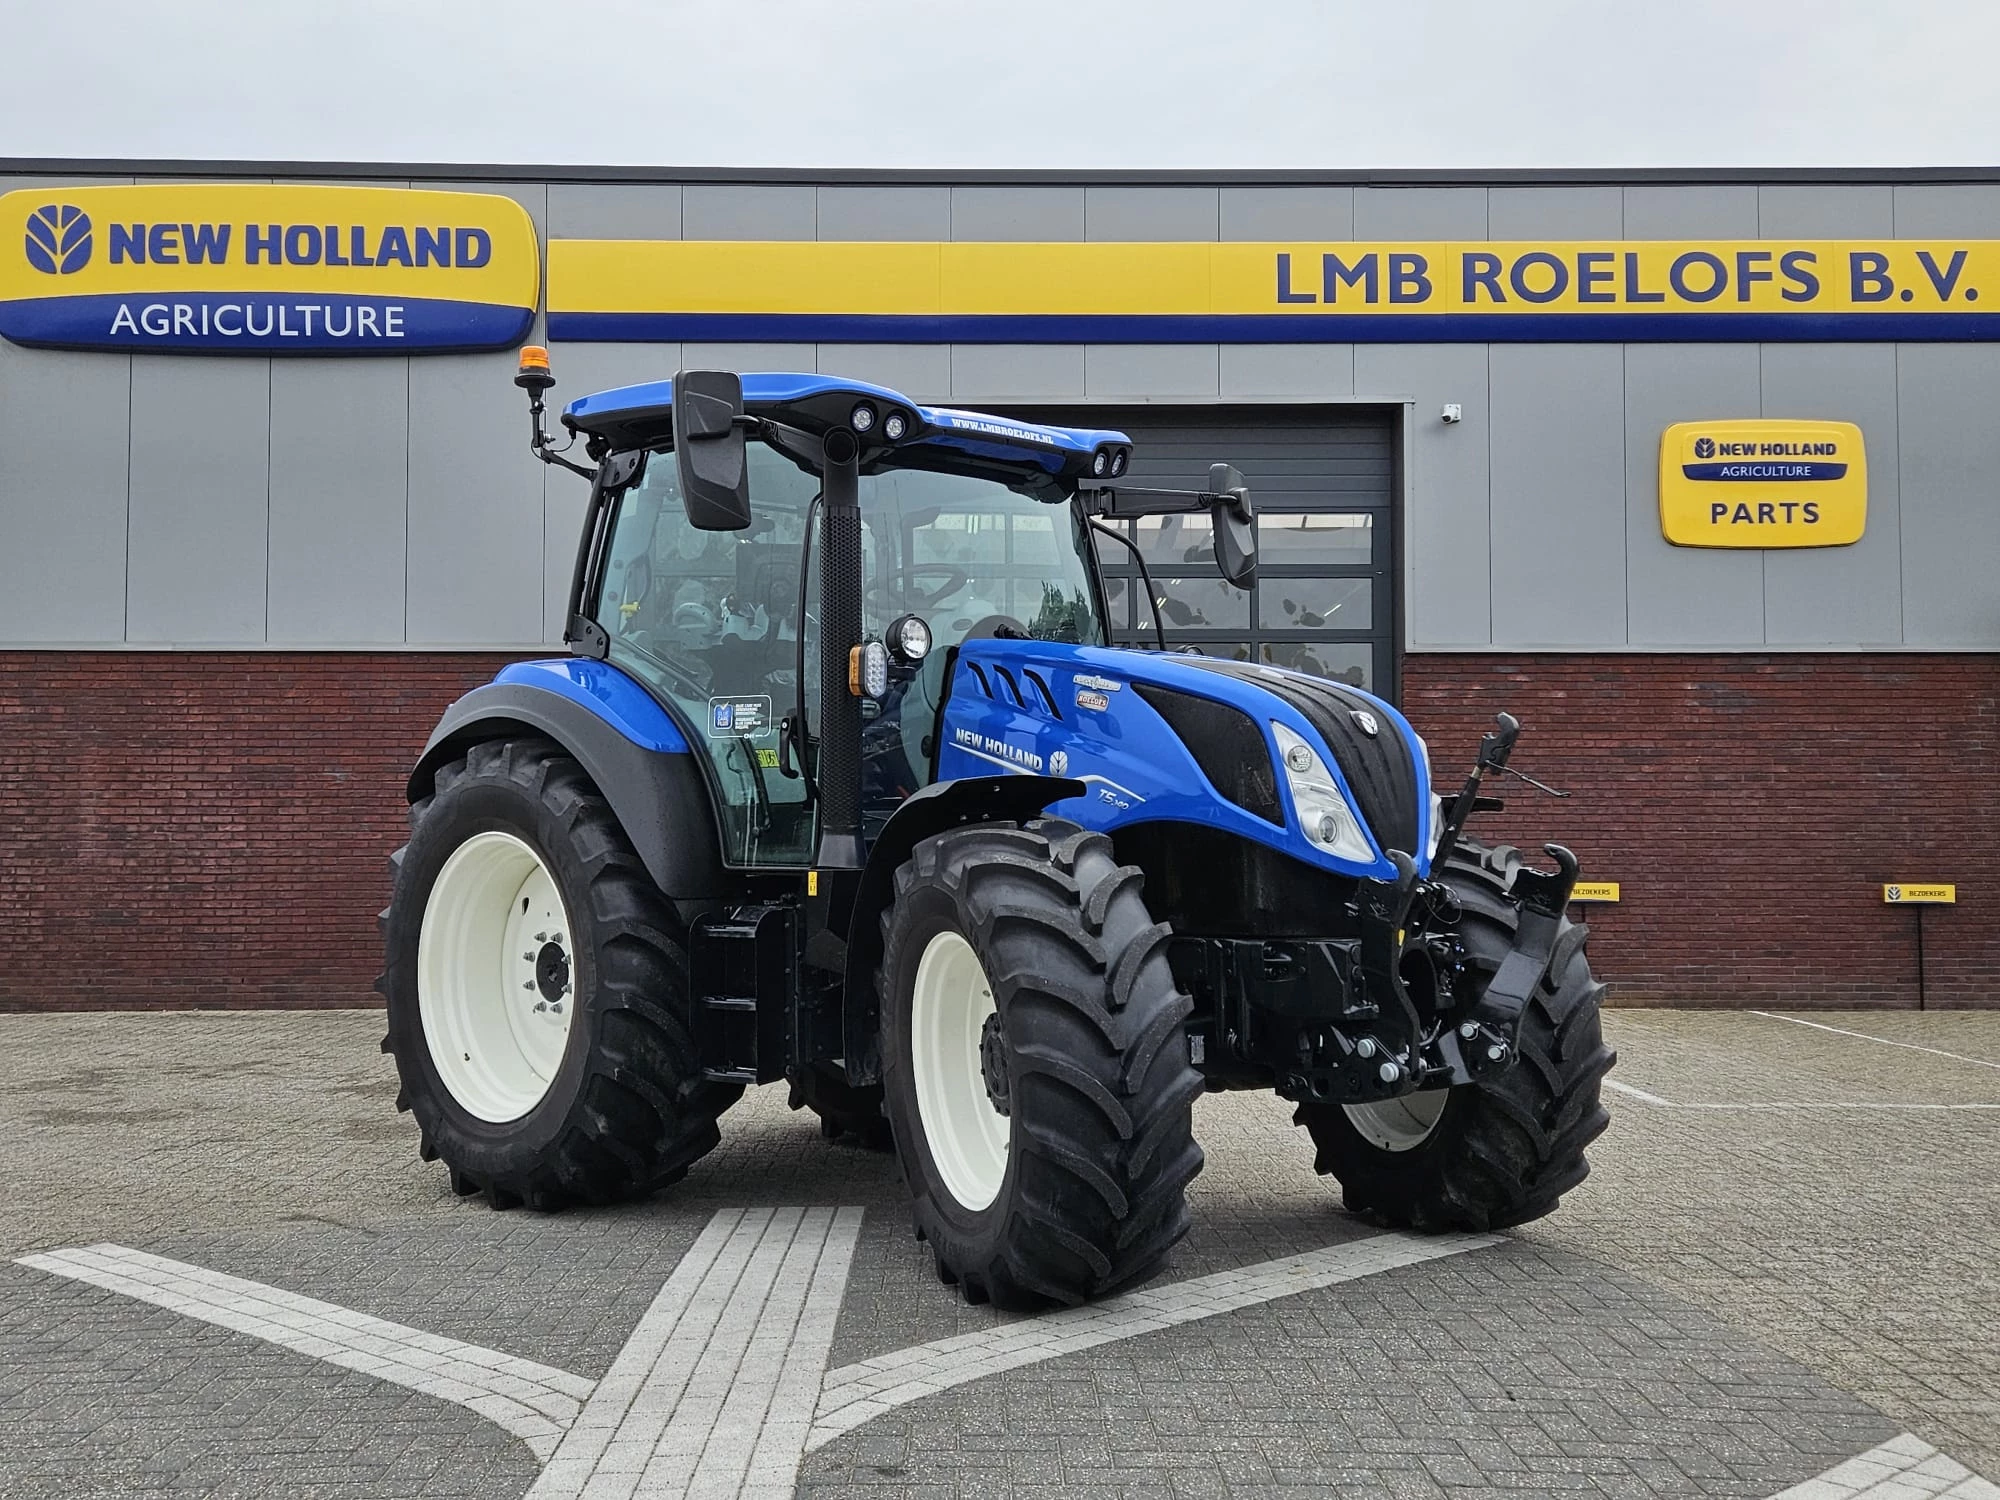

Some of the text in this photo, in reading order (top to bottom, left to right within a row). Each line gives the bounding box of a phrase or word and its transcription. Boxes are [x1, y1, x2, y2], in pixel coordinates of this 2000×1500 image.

[109, 223, 492, 268] NEW HOLLAND
[1277, 250, 1979, 304] LMB ROELOFS B.V.
[109, 303, 405, 338] AGRICULTURE
[951, 417, 1054, 445] WWW.LMBROELOFS.NL
[1719, 443, 1837, 456] NEW HOLLAND
[1720, 465, 1812, 477] AGRICULTURE
[1711, 502, 1820, 525] PARTS
[956, 727, 1043, 772] NEW HOLLAND
